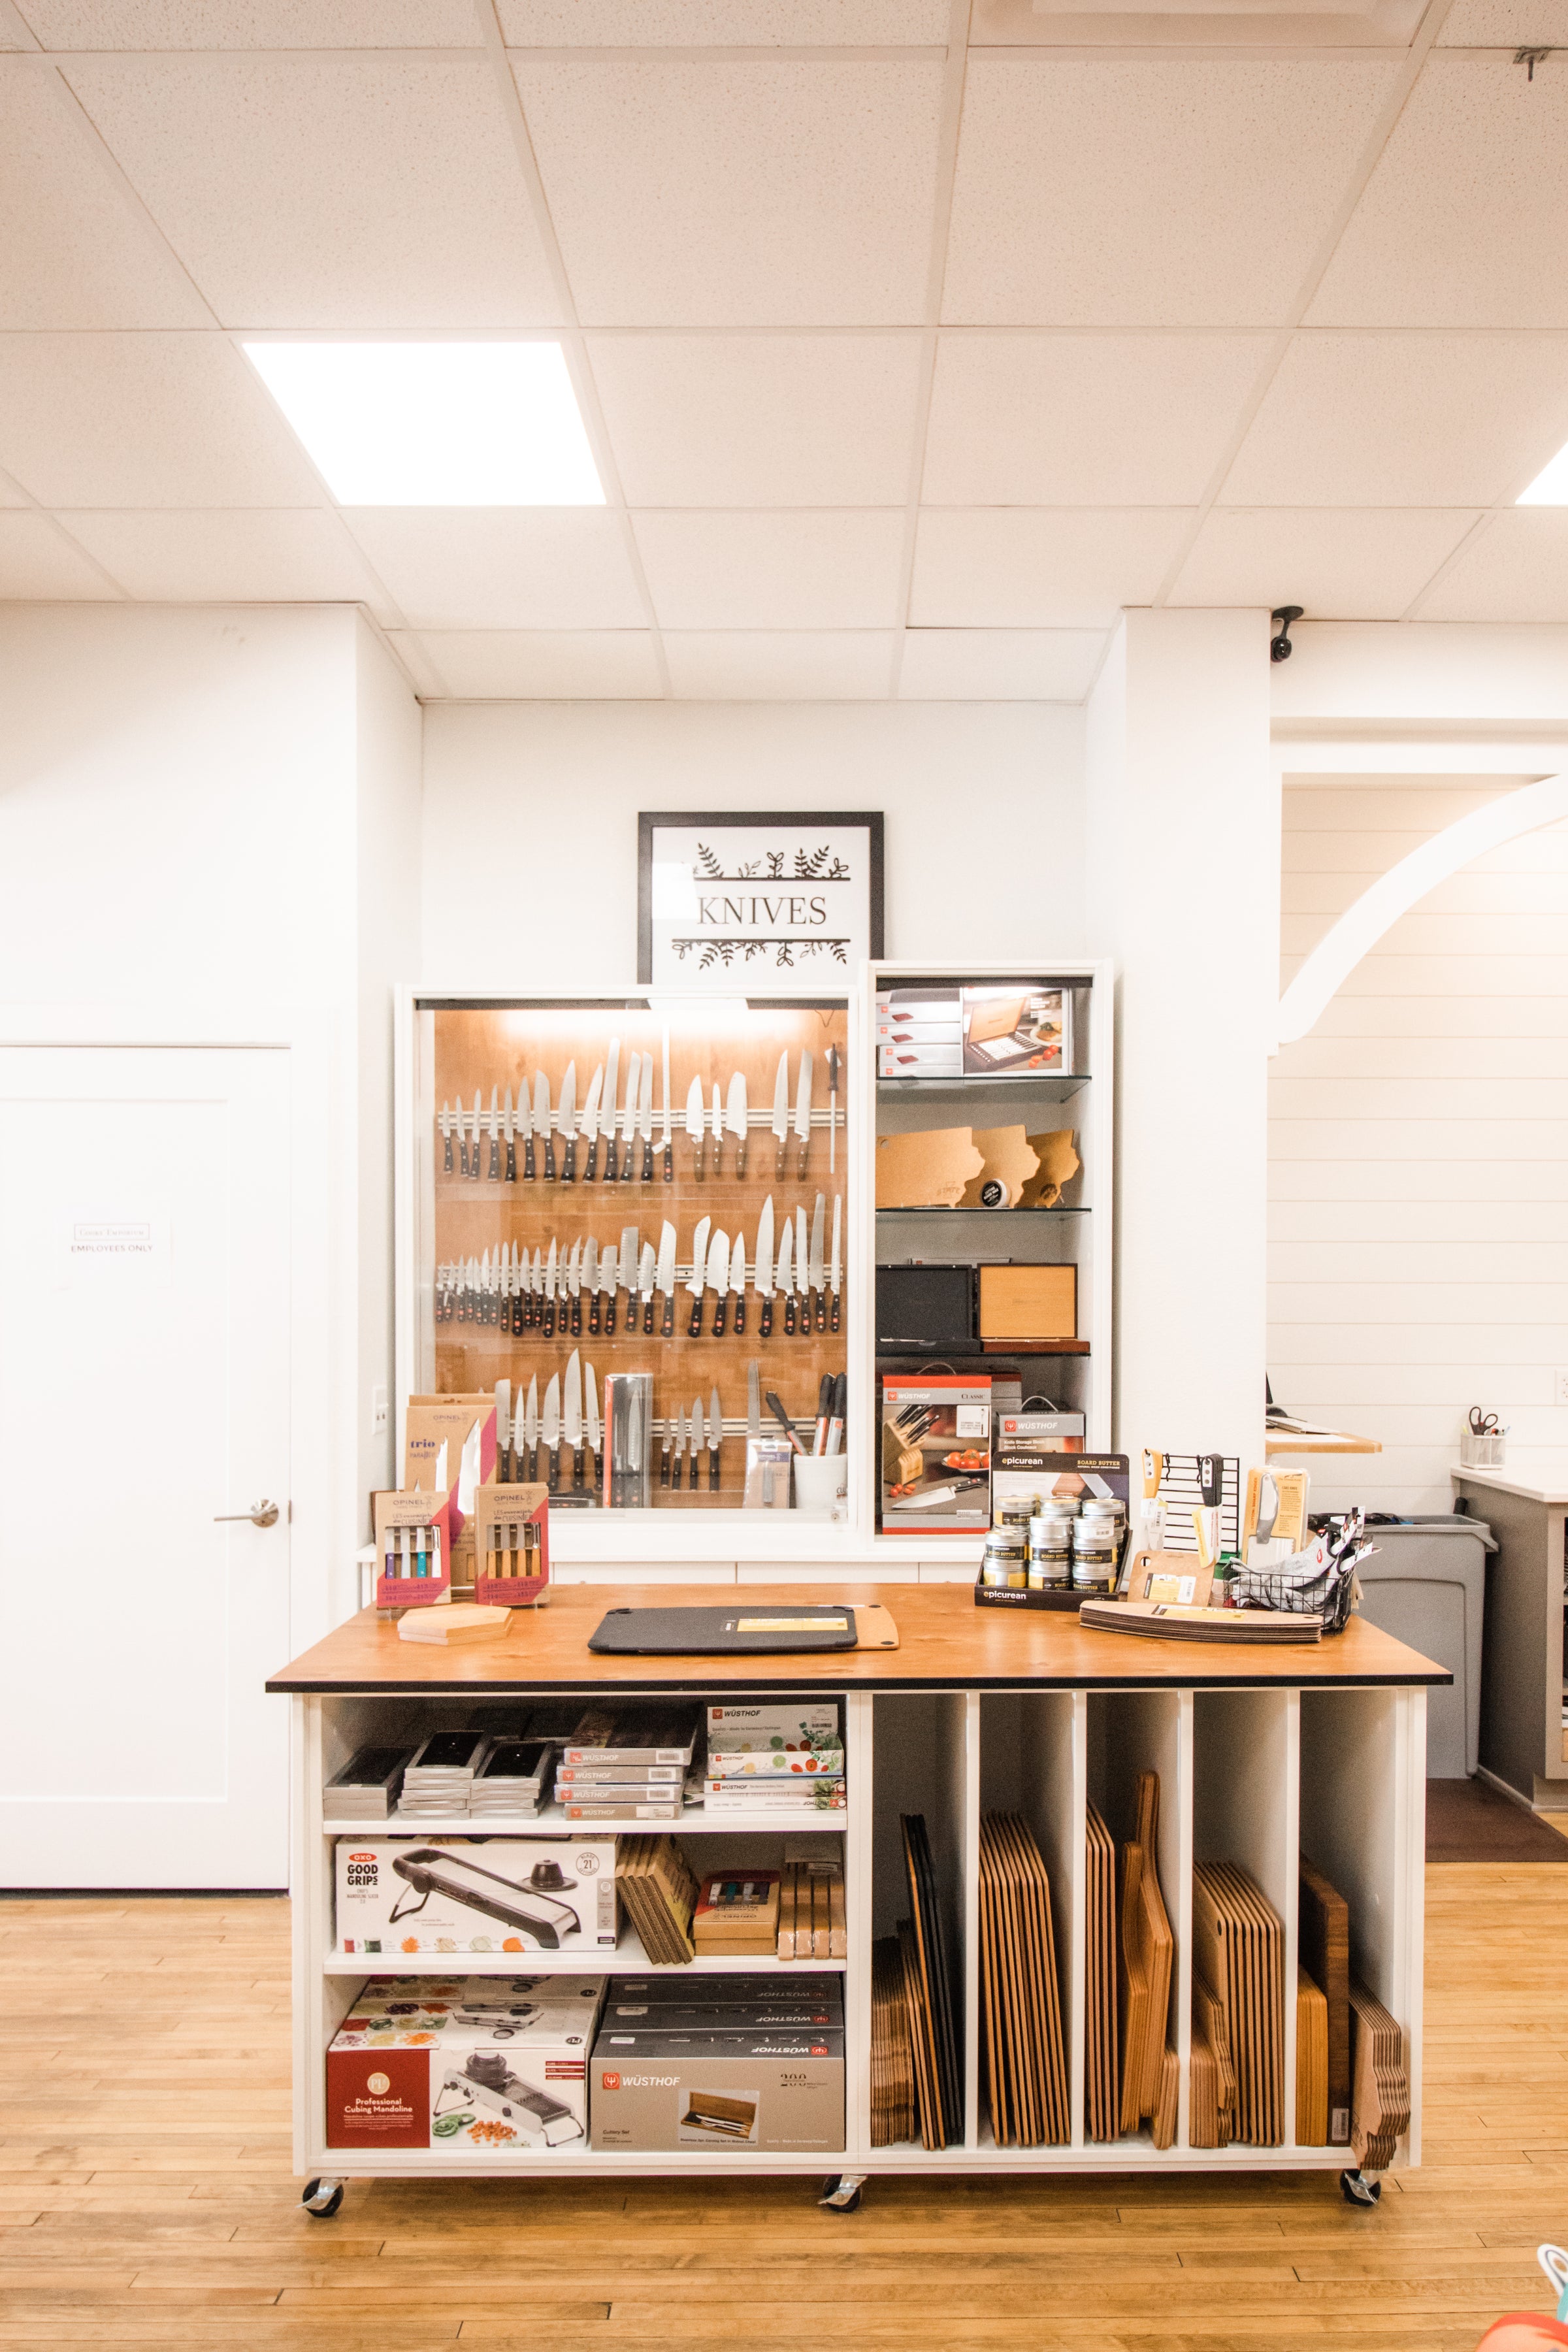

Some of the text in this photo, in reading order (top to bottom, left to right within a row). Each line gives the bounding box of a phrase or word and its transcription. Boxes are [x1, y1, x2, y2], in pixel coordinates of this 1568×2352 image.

[697, 896, 826, 925] KNIVES
[71, 1244, 153, 1253] EMPLOYEES ONLY
[410, 1439, 436, 1448] trio
[1002, 1457, 1043, 1465] epicurean
[983, 1590, 1026, 1600] epicurean
[348, 1864, 378, 1874] GOOD
[583, 1859, 593, 1869] 21
[348, 1875, 378, 1886] GRIPS
[622, 2074, 681, 2087] WÜSTHOF
[344, 2105, 372, 2114] Cubing
